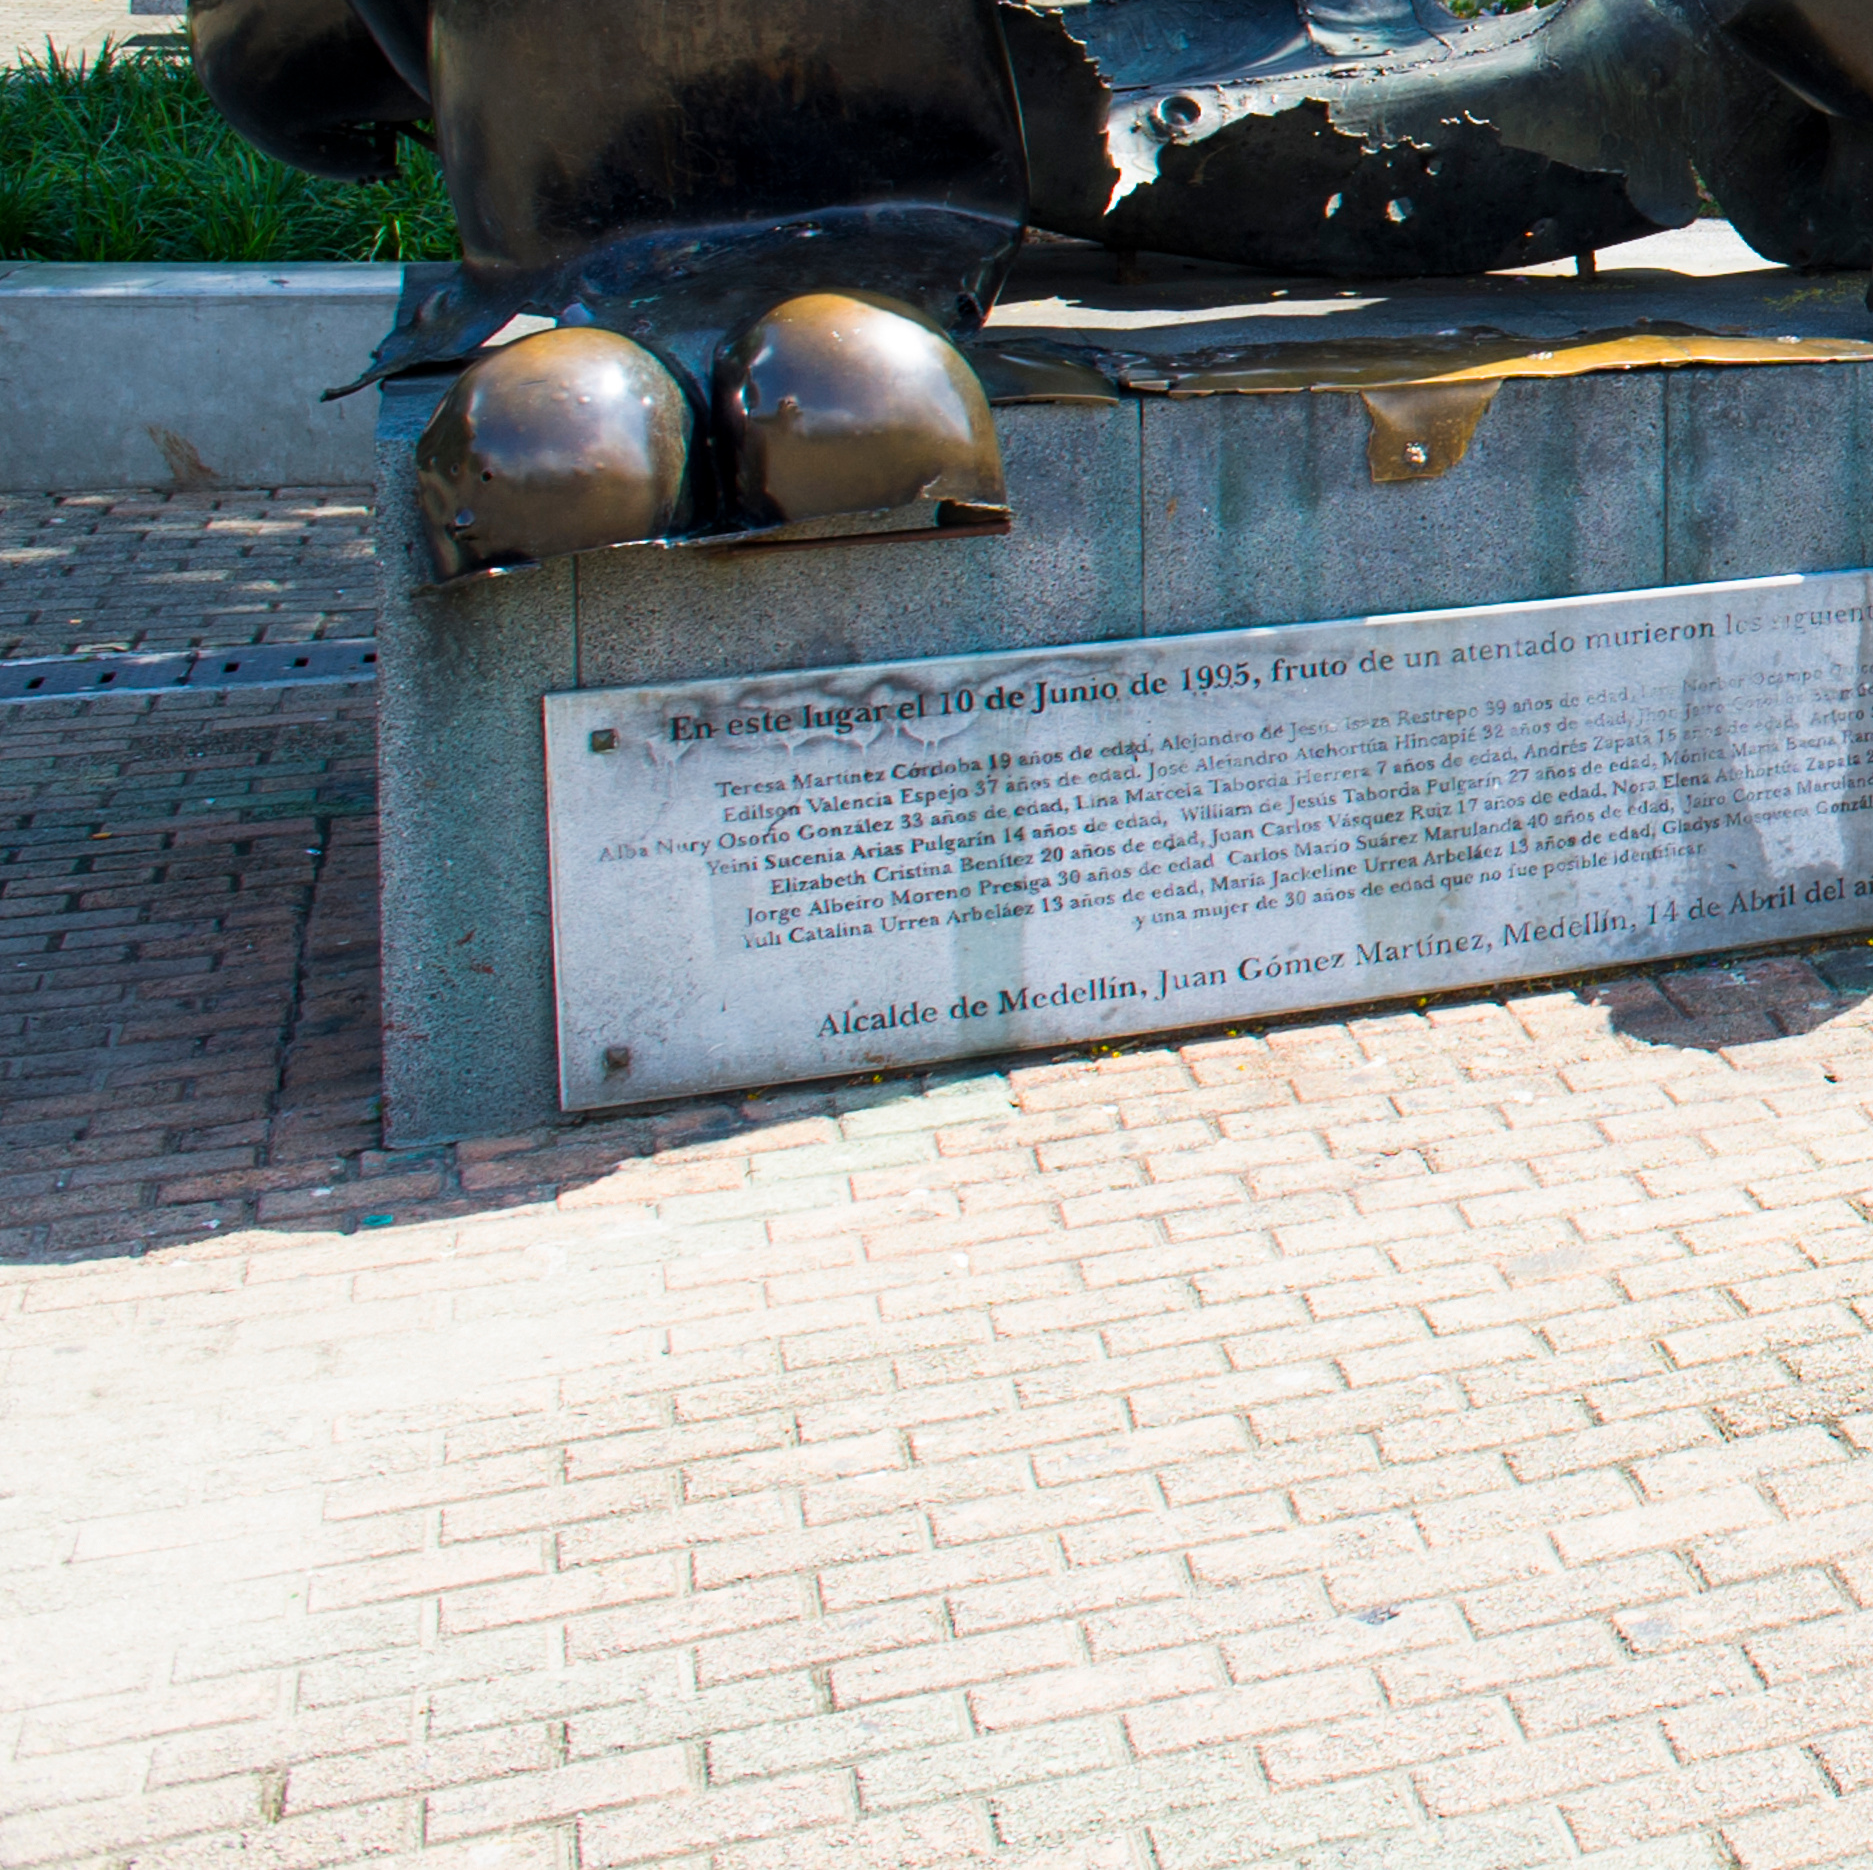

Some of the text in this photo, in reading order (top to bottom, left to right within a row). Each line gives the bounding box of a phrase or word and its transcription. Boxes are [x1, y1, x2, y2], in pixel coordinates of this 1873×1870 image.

[725, 706, 792, 736] este
[802, 703, 888, 733] lugar
[896, 691, 924, 719] el
[940, 688, 975, 716] 10
[983, 681, 1025, 710] de
[1029, 672, 1119, 714] Junio
[1130, 671, 1168, 696] de
[1179, 661, 1262, 696] 1995,
[1270, 656, 1348, 682] fruto
[1358, 648, 1395, 673] de
[1404, 649, 1440, 668] un
[1450, 629, 1575, 664] atentado
[1585, 621, 1715, 650] murieron
[714, 779, 786, 798] Teresa
[890, 756, 982, 779] Córdoba
[987, 752, 1011, 770] 19
[1017, 750, 1064, 766] años
[1068, 744, 1092, 761] de
[1511, 697, 1553, 713] años
[1558, 691, 1579, 708] de
[722, 803, 801, 823] Edilson
[806, 794, 893, 813] Valencia
[899, 782, 969, 807] Espejo
[973, 778, 998, 796] 37
[1004, 775, 1050, 793] años
[1056, 771, 1080, 787] de
[1481, 723, 1504, 740] 32
[1557, 715, 1578, 732] de
[796, 818, 893, 840] González
[899, 811, 923, 829] 33
[929, 809, 978, 826] años
[982, 803, 1007, 819] de
[1207, 775, 1289, 794] Taborda
[1375, 759, 1388, 775] 7
[1391, 757, 1435, 774] años
[1440, 752, 1463, 768] de
[1523, 737, 1587, 759] Andrés
[1592, 729, 1655, 753] Zapata
[706, 858, 758, 876] Yeini
[763, 850, 844, 870] Sucenia
[850, 843, 904, 860] Arias
[909, 830, 996, 855] Pulgarín
[1002, 825, 1025, 843] 14
[1031, 822, 1077, 839] años
[1083, 817, 1108, 833] de
[1179, 804, 1253, 822] William
[1258, 801, 1282, 813] de
[1285, 791, 1337, 815] Jesús
[1342, 780, 1420, 803] Taborda
[1426, 771, 1502, 796] Pulgarín
[1507, 767, 1530, 784] 27
[1534, 765, 1576, 780] años
[1580, 759, 1602, 776] de
[1662, 746, 1724, 766] Mónica
[745, 906, 802, 927] Jorge
[806, 897, 884, 916] Albeiro
[889, 885, 972, 906] Moreno
[977, 876, 1052, 896] Presiga
[1056, 868, 1081, 886] 30
[1086, 866, 1132, 882] años
[1137, 860, 1162, 876] de
[1166, 852, 1215, 873] edad
[1226, 846, 1289, 865] Carlos
[1293, 841, 1351, 857] Mario
[1355, 833, 1418, 850] Suárez
[1423, 816, 1523, 842] Marulanda
[1525, 812, 1549, 828] 40
[1552, 809, 1594, 825] años
[1599, 803, 1622, 820] de
[769, 869, 866, 895] Elizabeth
[872, 863, 953, 882] Cristina
[959, 853, 1034, 873] Benítez
[1039, 845, 1064, 863] 20
[1069, 843, 1116, 860] años
[1121, 837, 1146, 854] de
[1209, 827, 1255, 849] Juan
[1259, 818, 1322, 837] Carlos
[1409, 804, 1452, 820] Ruiz
[1457, 796, 1478, 814] 17
[1483, 794, 1525, 811] años
[1530, 790, 1553, 805] de
[1661, 771, 1710, 789] Elena
[787, 922, 873, 943] Catalina
[880, 915, 940, 932] Urrea
[945, 902, 1035, 925] Arbeláez
[1040, 894, 1064, 913] 13
[1068, 893, 1116, 910] años
[1121, 887, 1146, 903] de
[1209, 872, 1266, 892] María
[1269, 862, 1358, 890] Jackeline
[1363, 855, 1418, 873] Urrea
[1422, 843, 1503, 866] Arbeláez
[1508, 837, 1529, 855] 13
[1534, 834, 1577, 851] años
[1580, 829, 1602, 846] de
[1661, 815, 1720, 834] Gladys
[1131, 914, 1145, 930] y
[1150, 909, 1187, 923] una
[1191, 901, 1250, 920] mujer
[1255, 894, 1279, 910] de
[1284, 889, 1307, 907] 30
[1311, 887, 1356, 903] años
[1360, 881, 1384, 897] de
[1389, 873, 1435, 894] edad
[1439, 872, 1474, 892] que
[1479, 869, 1501, 883] no
[1507, 862, 1539, 879] fue
[1543, 851, 1608, 879] posible
[815, 1000, 939, 1038] Alcalde
[948, 994, 989, 1019] de
[997, 975, 1148, 1015] Medellín,
[1152, 968, 1227, 1000] Juan
[1236, 951, 1345, 981] Gómez
[1354, 933, 1494, 966] Martínez,
[1502, 908, 1637, 947] Medellín,
[1648, 899, 1679, 926] 14
[1687, 895, 1722, 920] de
[1727, 883, 1797, 915] Abril
[1804, 876, 1847, 904] del
